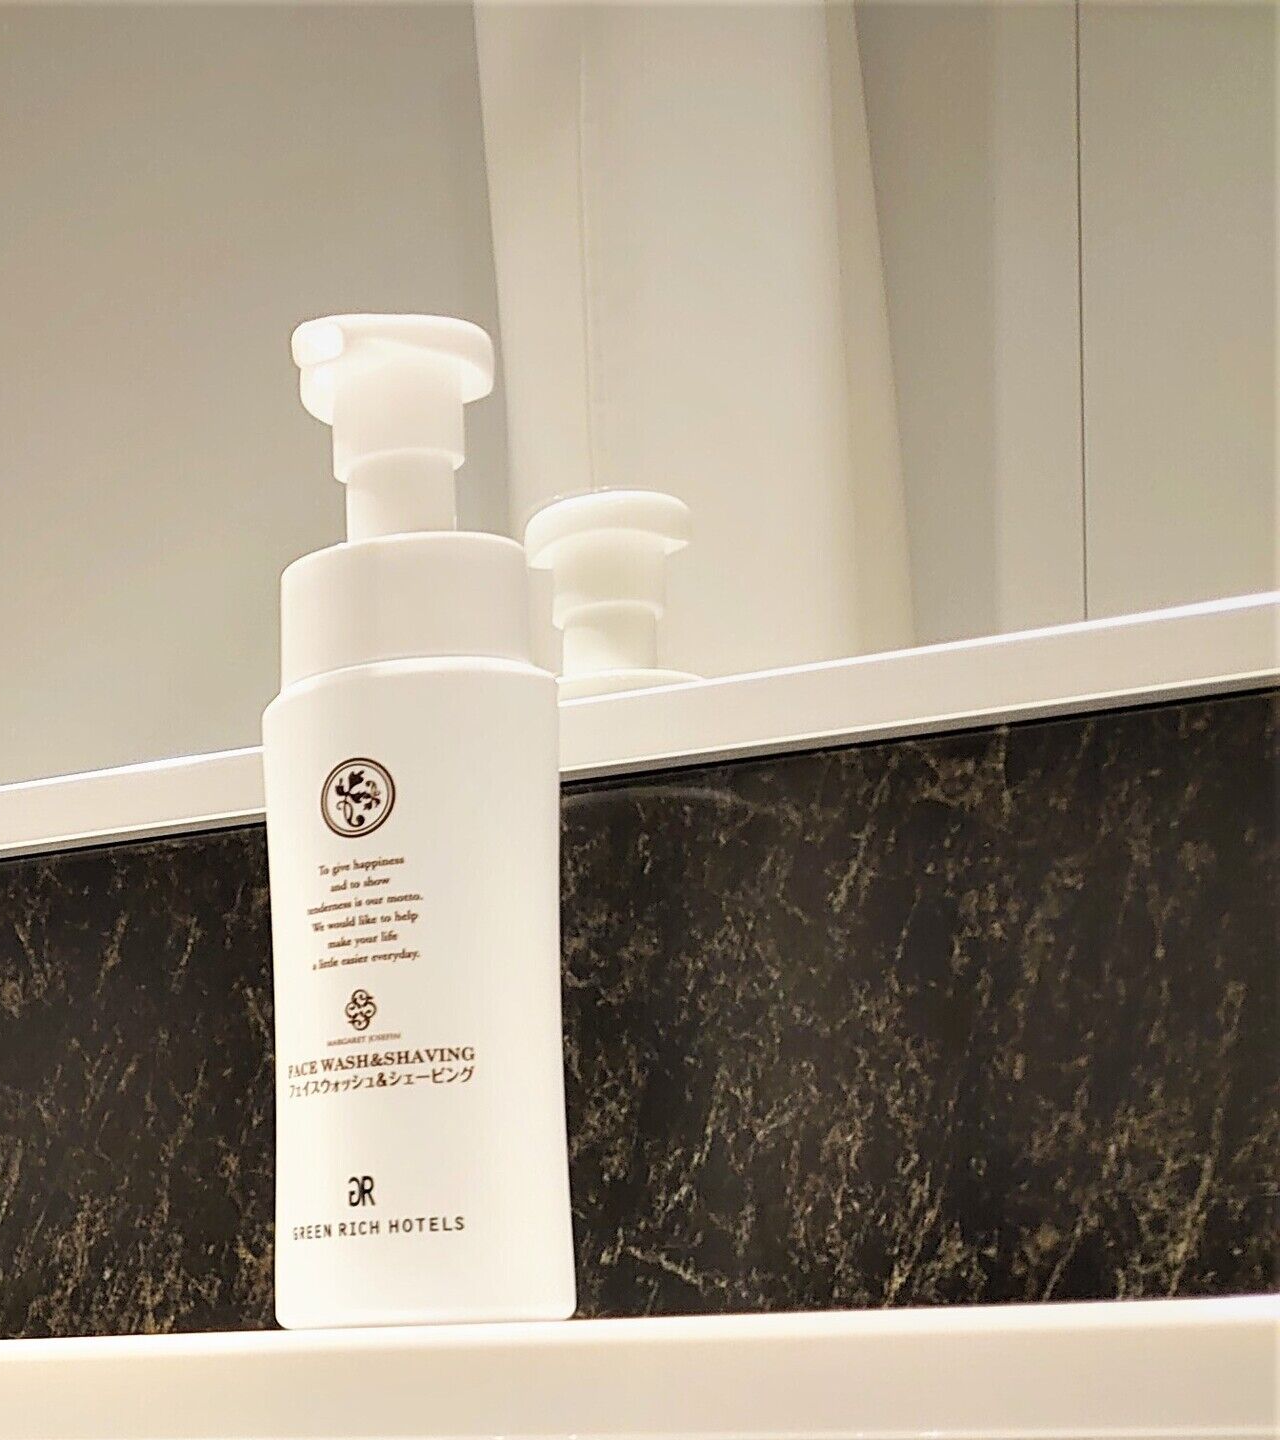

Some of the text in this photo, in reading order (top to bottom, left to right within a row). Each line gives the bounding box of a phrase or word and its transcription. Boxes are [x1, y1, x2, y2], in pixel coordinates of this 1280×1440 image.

[318, 856, 405, 876] To give happiness
[363, 876, 391, 887] show
[354, 896, 363, 907] is
[365, 897, 383, 906] our
[327, 915, 355, 928] would
[358, 913, 377, 925] like
[381, 914, 392, 923] to
[394, 909, 419, 924] help
[327, 929, 398, 949] make your life
[341, 953, 369, 966] easier
[288, 1046, 476, 1080] FACE WASH&SHAVING
[292, 1215, 466, 1241] GREEN RICH HOTELS
